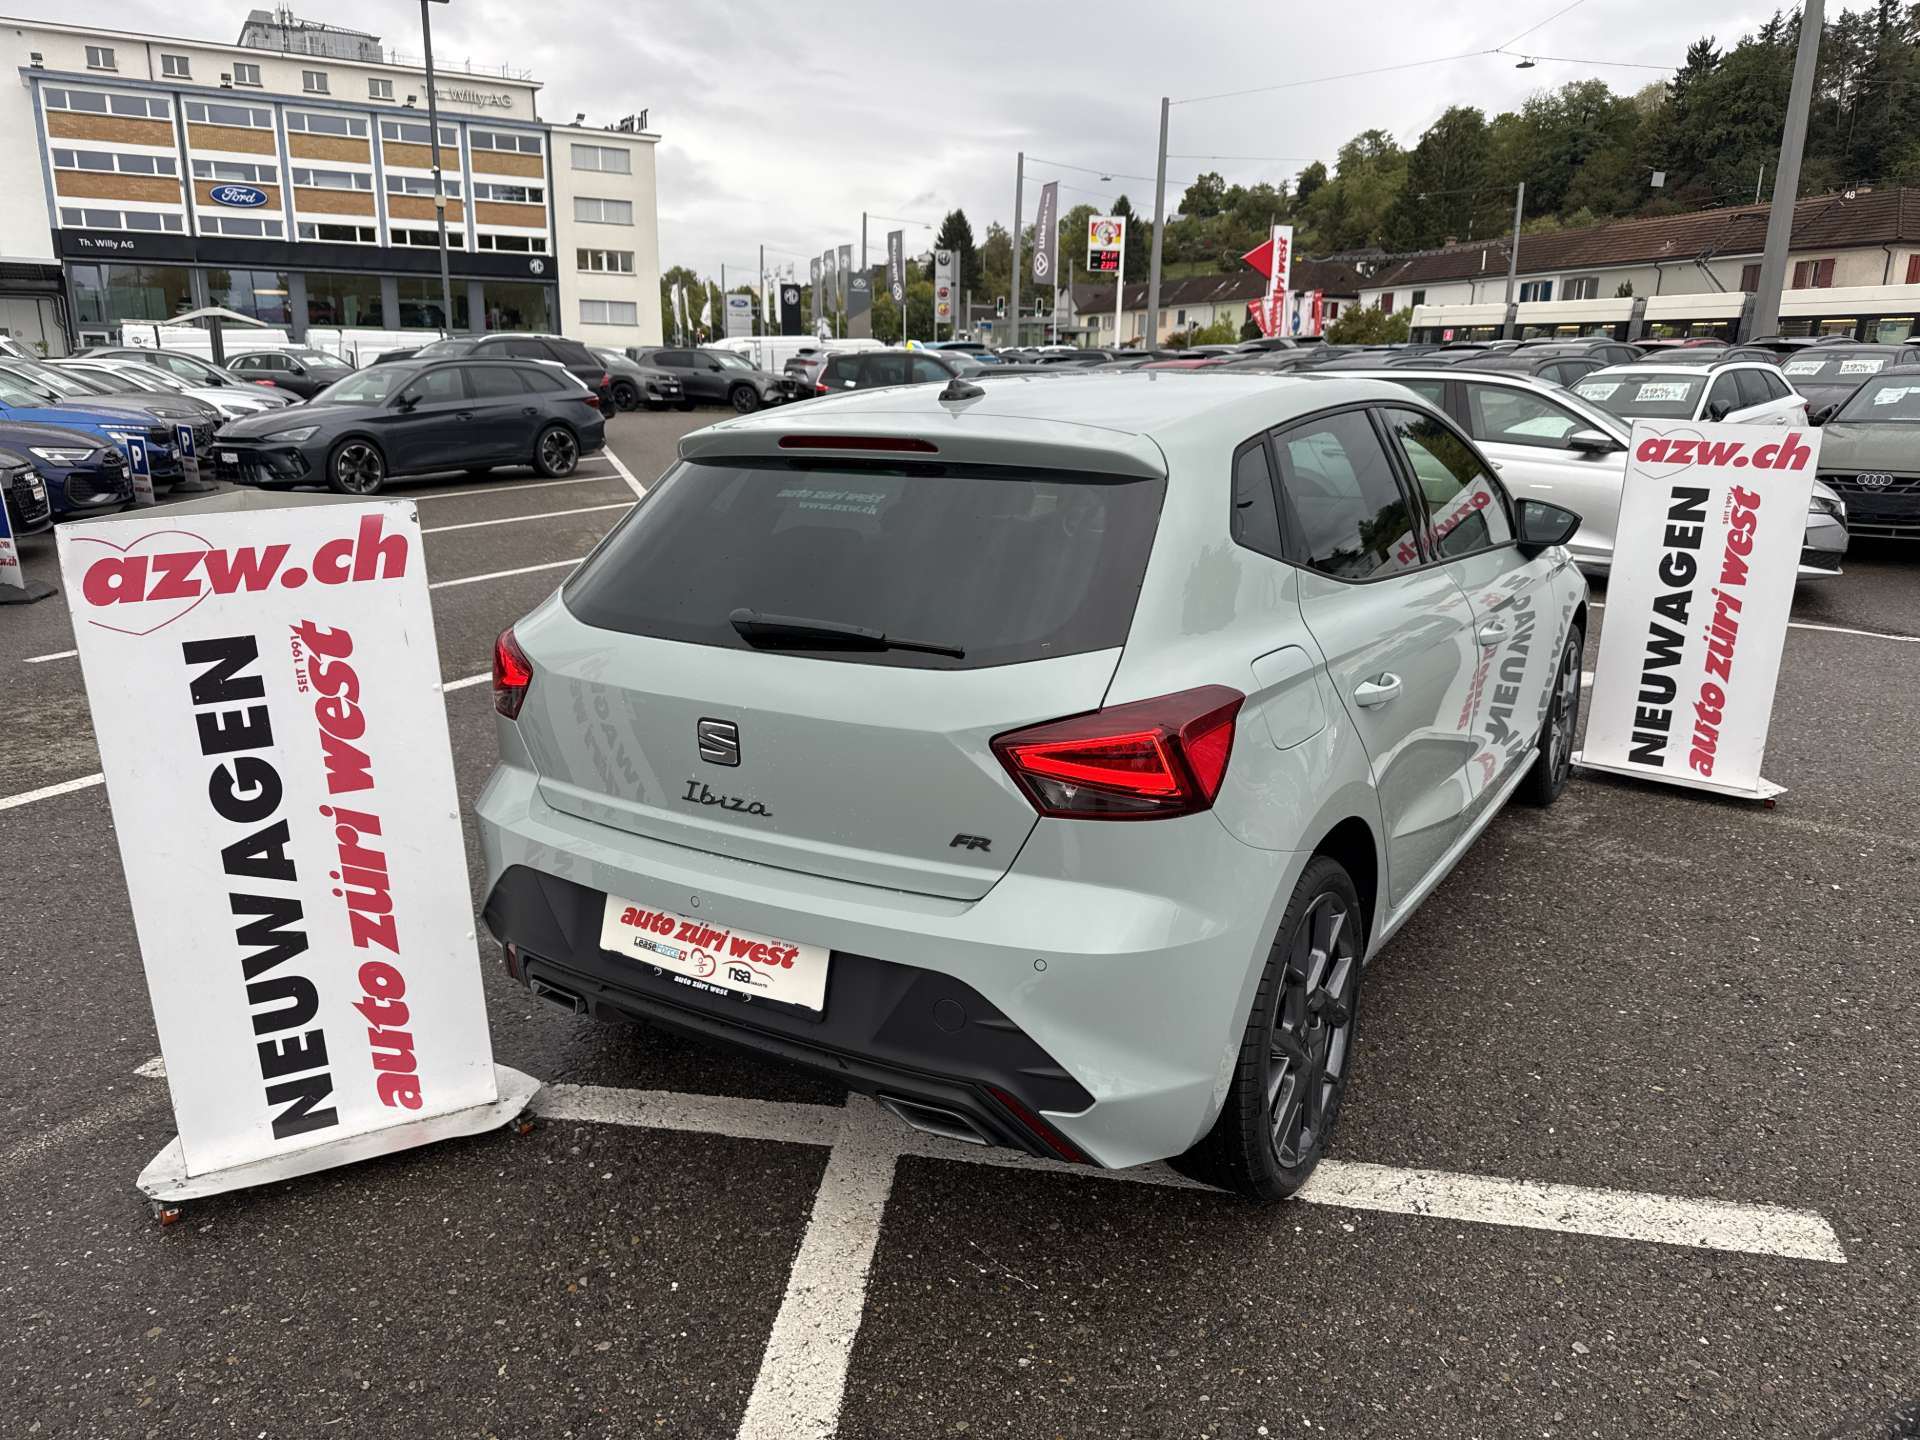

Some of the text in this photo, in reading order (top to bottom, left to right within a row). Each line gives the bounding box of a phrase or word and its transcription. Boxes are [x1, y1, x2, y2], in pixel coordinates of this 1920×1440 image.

[448, 86, 487, 107] Willy
[490, 93, 512, 108] AG
[221, 187, 256, 203] Ford
[1844, 190, 1856, 199] 48
[78, 238, 135, 250] Th. Willy AG
[784, 288, 799, 305] MG
[181, 431, 190, 453] P
[1635, 432, 1812, 471] azw.ch
[131, 445, 142, 470] P
[1722, 492, 1735, 525] SEIT 1991
[82, 514, 409, 607] azw.ch
[1628, 486, 1710, 768] NEUWAGEN
[1689, 485, 1761, 778] auto züri west
[289, 635, 309, 693] SEIT 1991
[682, 780, 773, 817] Ibiza
[949, 832, 992, 852] FR
[288, 619, 424, 1111] auto züri west
[182, 634, 339, 1141] NEUWAGEN
[620, 906, 800, 969] auto züri west
[673, 975, 729, 997] auto züri west
[728, 966, 751, 984] nsa
